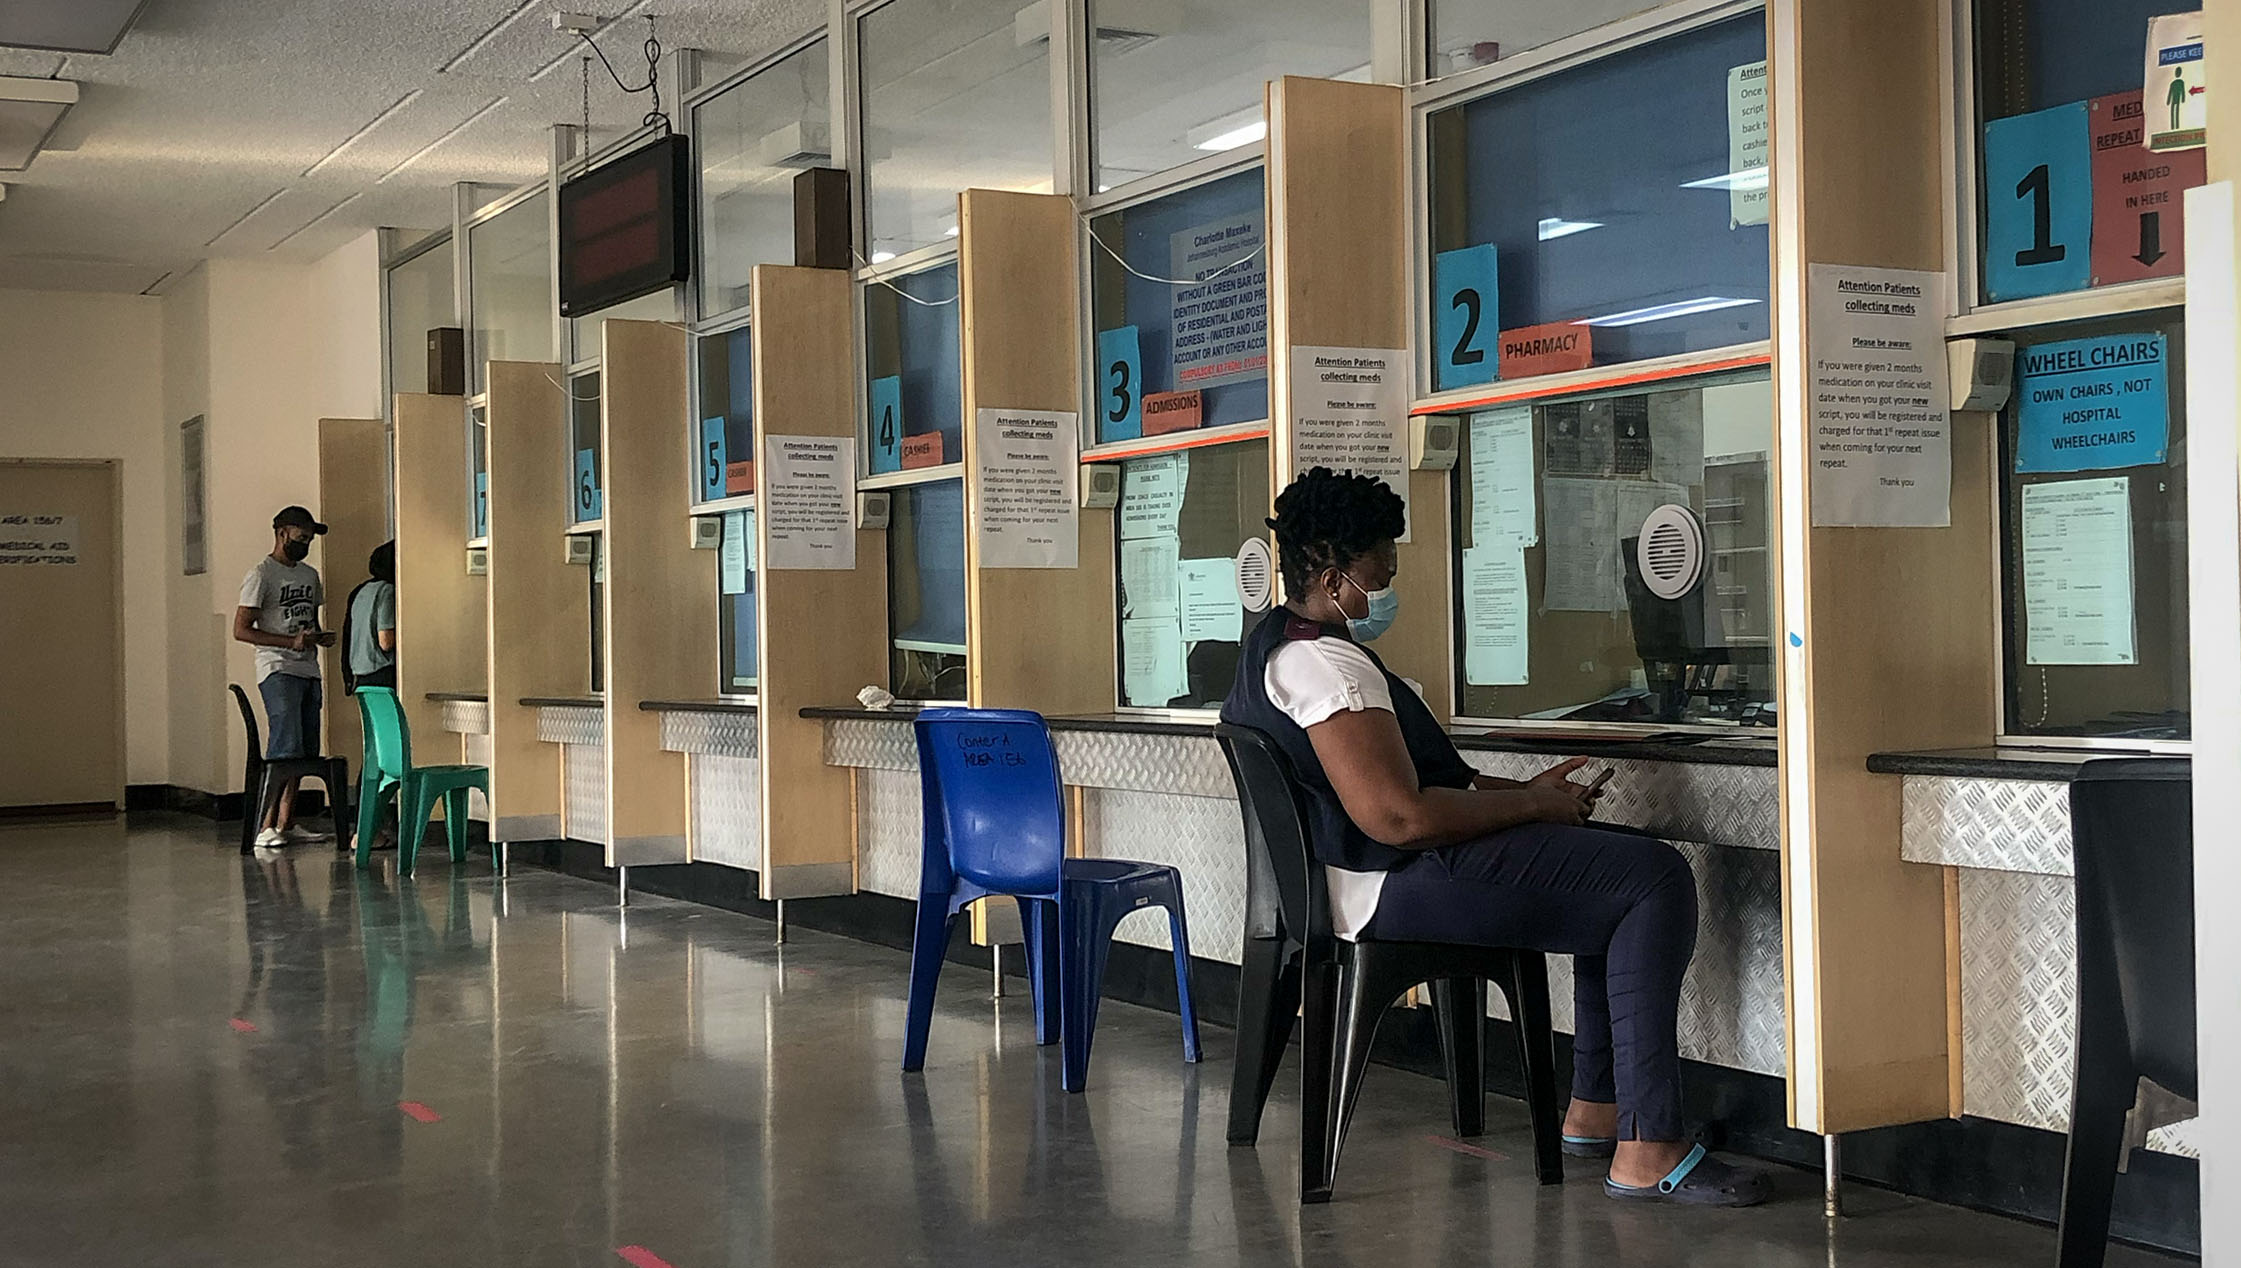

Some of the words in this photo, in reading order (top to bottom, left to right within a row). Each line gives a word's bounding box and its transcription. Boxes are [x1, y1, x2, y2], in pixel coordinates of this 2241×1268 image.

[1741, 88, 1762, 98] Once
[1742, 104, 1763, 116] script
[1742, 122, 1761, 133] back
[2097, 128, 2140, 147] REPEAT
[2122, 166, 2170, 184] HANDED
[1744, 192, 1757, 203] the
[2126, 197, 2138, 208] IN
[2141, 191, 2169, 206] HERE
[2016, 164, 2066, 267] 1
[1193, 231, 1225, 247] Charlotte
[1195, 271, 1205, 281] NO
[1177, 286, 1206, 303] WITHOUT
[1207, 286, 1212, 295] A
[1213, 280, 1236, 294] GREEN
[1237, 276, 1252, 286] BAR
[1838, 279, 1882, 292] Attention
[1885, 282, 1920, 295] Patients
[1174, 304, 1201, 319] IDENTITY
[1201, 295, 1238, 313] DOCUMENT
[1239, 292, 1253, 302] AND
[1845, 300, 1890, 313] collecting
[1892, 302, 1916, 313] meds
[1177, 323, 1186, 333] OF
[1188, 315, 1229, 330] RESIDENTIAL
[1231, 310, 1244, 321] AND
[1452, 288, 1484, 365] 2
[1176, 333, 1205, 348] ADDRESS
[1210, 326, 1235, 344] (WATER
[1236, 323, 1251, 334] AND
[1852, 337, 1876, 347] Please
[1877, 338, 1887, 347] be
[1174, 349, 1201, 364] ACCOUNT
[1202, 347, 1212, 359] OR
[1212, 344, 1225, 358] ANY
[1225, 340, 1246, 355] OTHER
[1506, 333, 1578, 359] PHARMACY
[1315, 357, 1352, 367] Attention
[1354, 358, 1386, 368] Patients
[2024, 350, 2086, 373] WHEEL
[2090, 341, 2160, 365] CHAIRS
[1818, 360, 1824, 369] If
[1825, 362, 1840, 371] you
[1864, 362, 1886, 373] given
[1887, 363, 1892, 372] 2
[1894, 363, 1923, 373] months
[1320, 373, 1357, 382] collecting
[1359, 373, 1381, 382] meds
[1818, 378, 1863, 387] medication
[1865, 380, 1876, 388] on
[1877, 381, 1894, 390] your
[1896, 380, 1915, 389] clinic
[1916, 381, 1932, 390] visit
[1109, 361, 1131, 422] 3
[2033, 388, 2064, 403] OWN
[2070, 383, 2113, 399] CHAIRS
[2124, 379, 2152, 393] NOT
[1146, 394, 1198, 414] ADMISSIONS
[1327, 400, 1346, 409] Please
[1818, 393, 1836, 403] date
[1838, 394, 1861, 403] when
[1862, 396, 1877, 405] you
[1880, 396, 1892, 406] got
[1893, 397, 1911, 406] your
[1912, 398, 1929, 406] new
[997, 417, 1030, 425] Attention
[1031, 419, 1058, 427] Patients
[1845, 412, 1860, 420] you
[1862, 410, 1876, 420] will
[1877, 411, 1887, 420] be
[1888, 412, 1927, 422] registered
[1928, 413, 1943, 422] and
[2062, 407, 2122, 424] HOSPITAL
[1336, 419, 1353, 428] given
[1355, 419, 1360, 427] 2
[880, 405, 895, 456] 4
[1002, 430, 1034, 438] collecting
[1036, 431, 1053, 439] meds
[1346, 432, 1362, 440] your
[1363, 431, 1380, 439] clinic
[1819, 426, 1851, 437] charged
[1852, 427, 1865, 436] for
[1866, 427, 1883, 436] that
[1895, 429, 1919, 438] repeat
[1921, 429, 1940, 438] issue
[2052, 431, 2136, 450] WHEELCHAIRS
[1349, 444, 1361, 452] got
[1819, 442, 1841, 452] when
[1843, 444, 1872, 454] coming
[1874, 443, 1885, 452] for
[1886, 445, 1904, 454] your
[1905, 445, 1922, 453] next
[709, 441, 719, 486] 5
[1358, 456, 1389, 464] registered
[1880, 478, 1900, 486] Thank
[581, 470, 592, 510] 6
